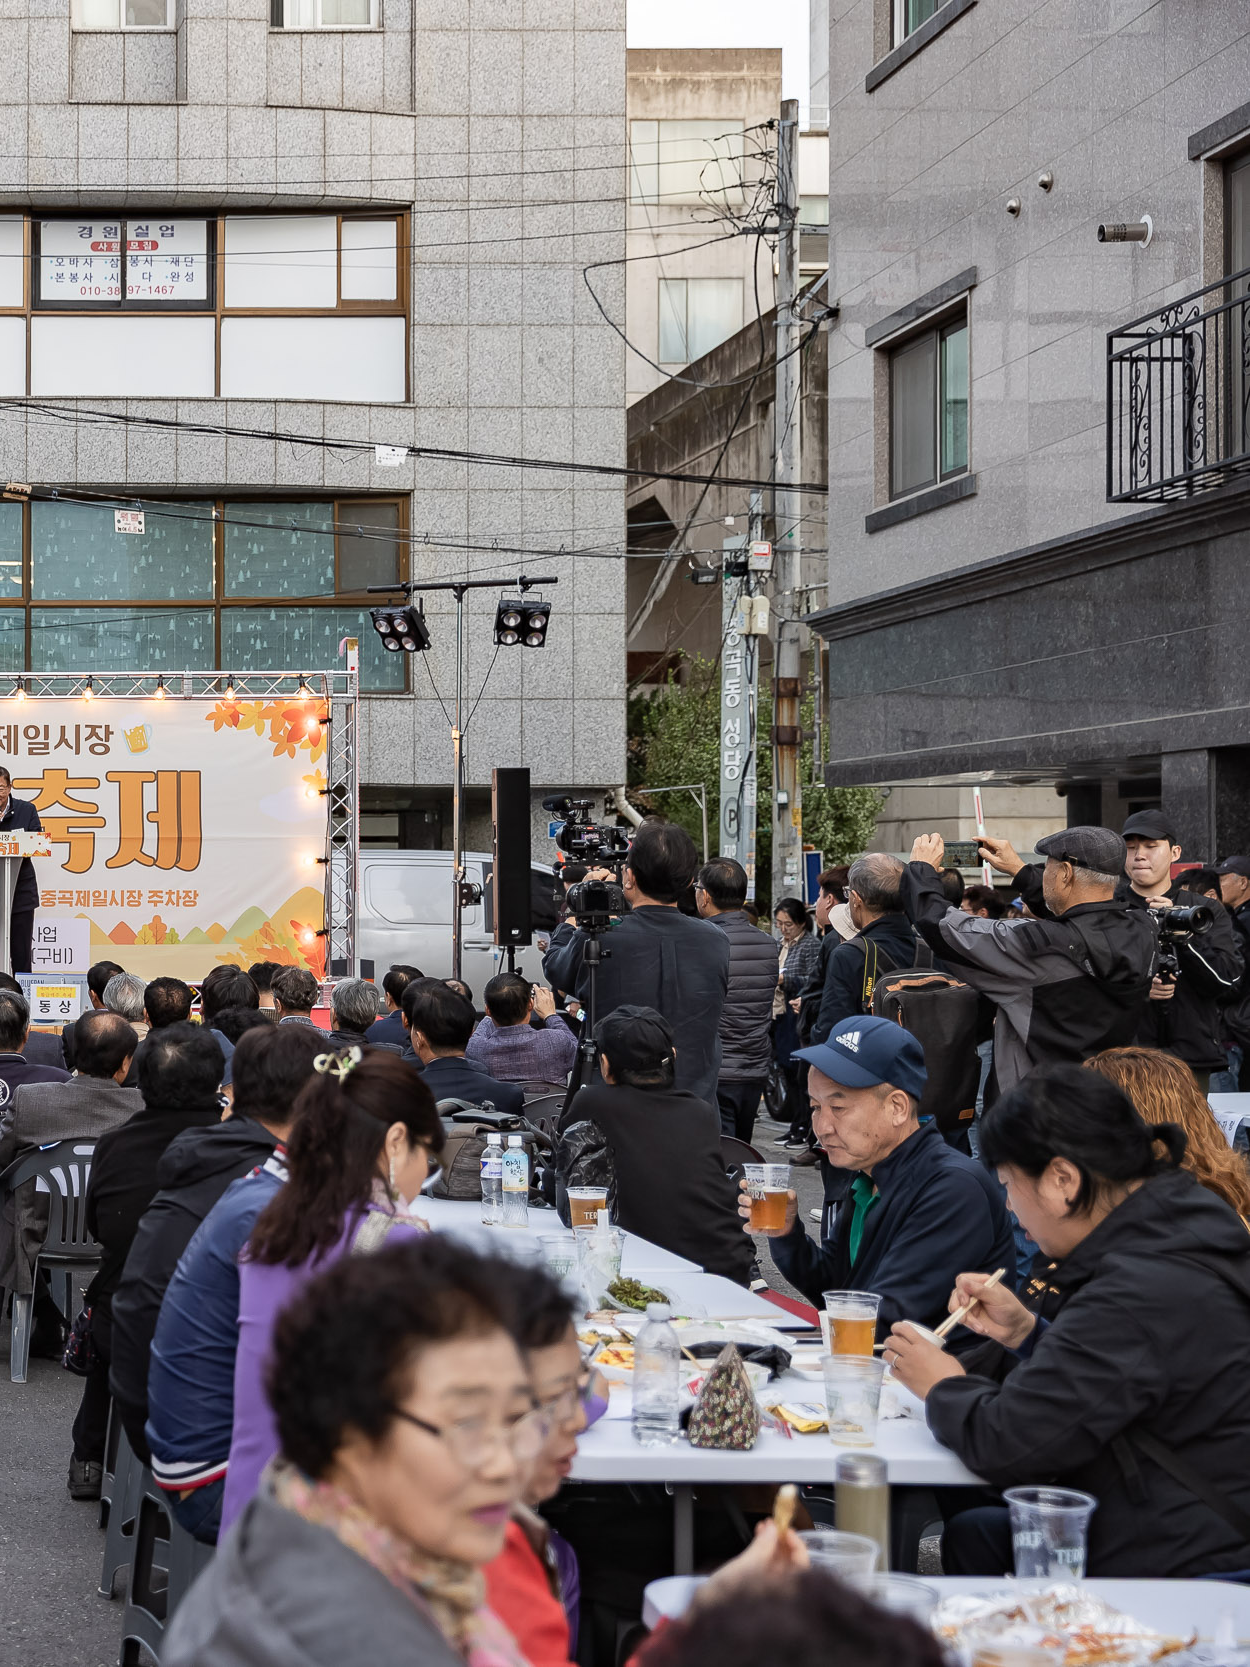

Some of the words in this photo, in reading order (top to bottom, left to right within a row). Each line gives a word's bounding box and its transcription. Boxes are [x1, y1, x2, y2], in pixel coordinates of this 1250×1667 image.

[170, 256, 195, 268] 재단
[170, 271, 195, 283] 완성
[724, 718, 742, 780] 성당
[40, 889, 143, 908] 중곡제일시장
[148, 889, 199, 908] 주차장
[865, 976, 873, 997] Nikon
[835, 1035, 859, 1053] adidas
[505, 1159, 521, 1170] 아침
[583, 1211, 597, 1220] TER
